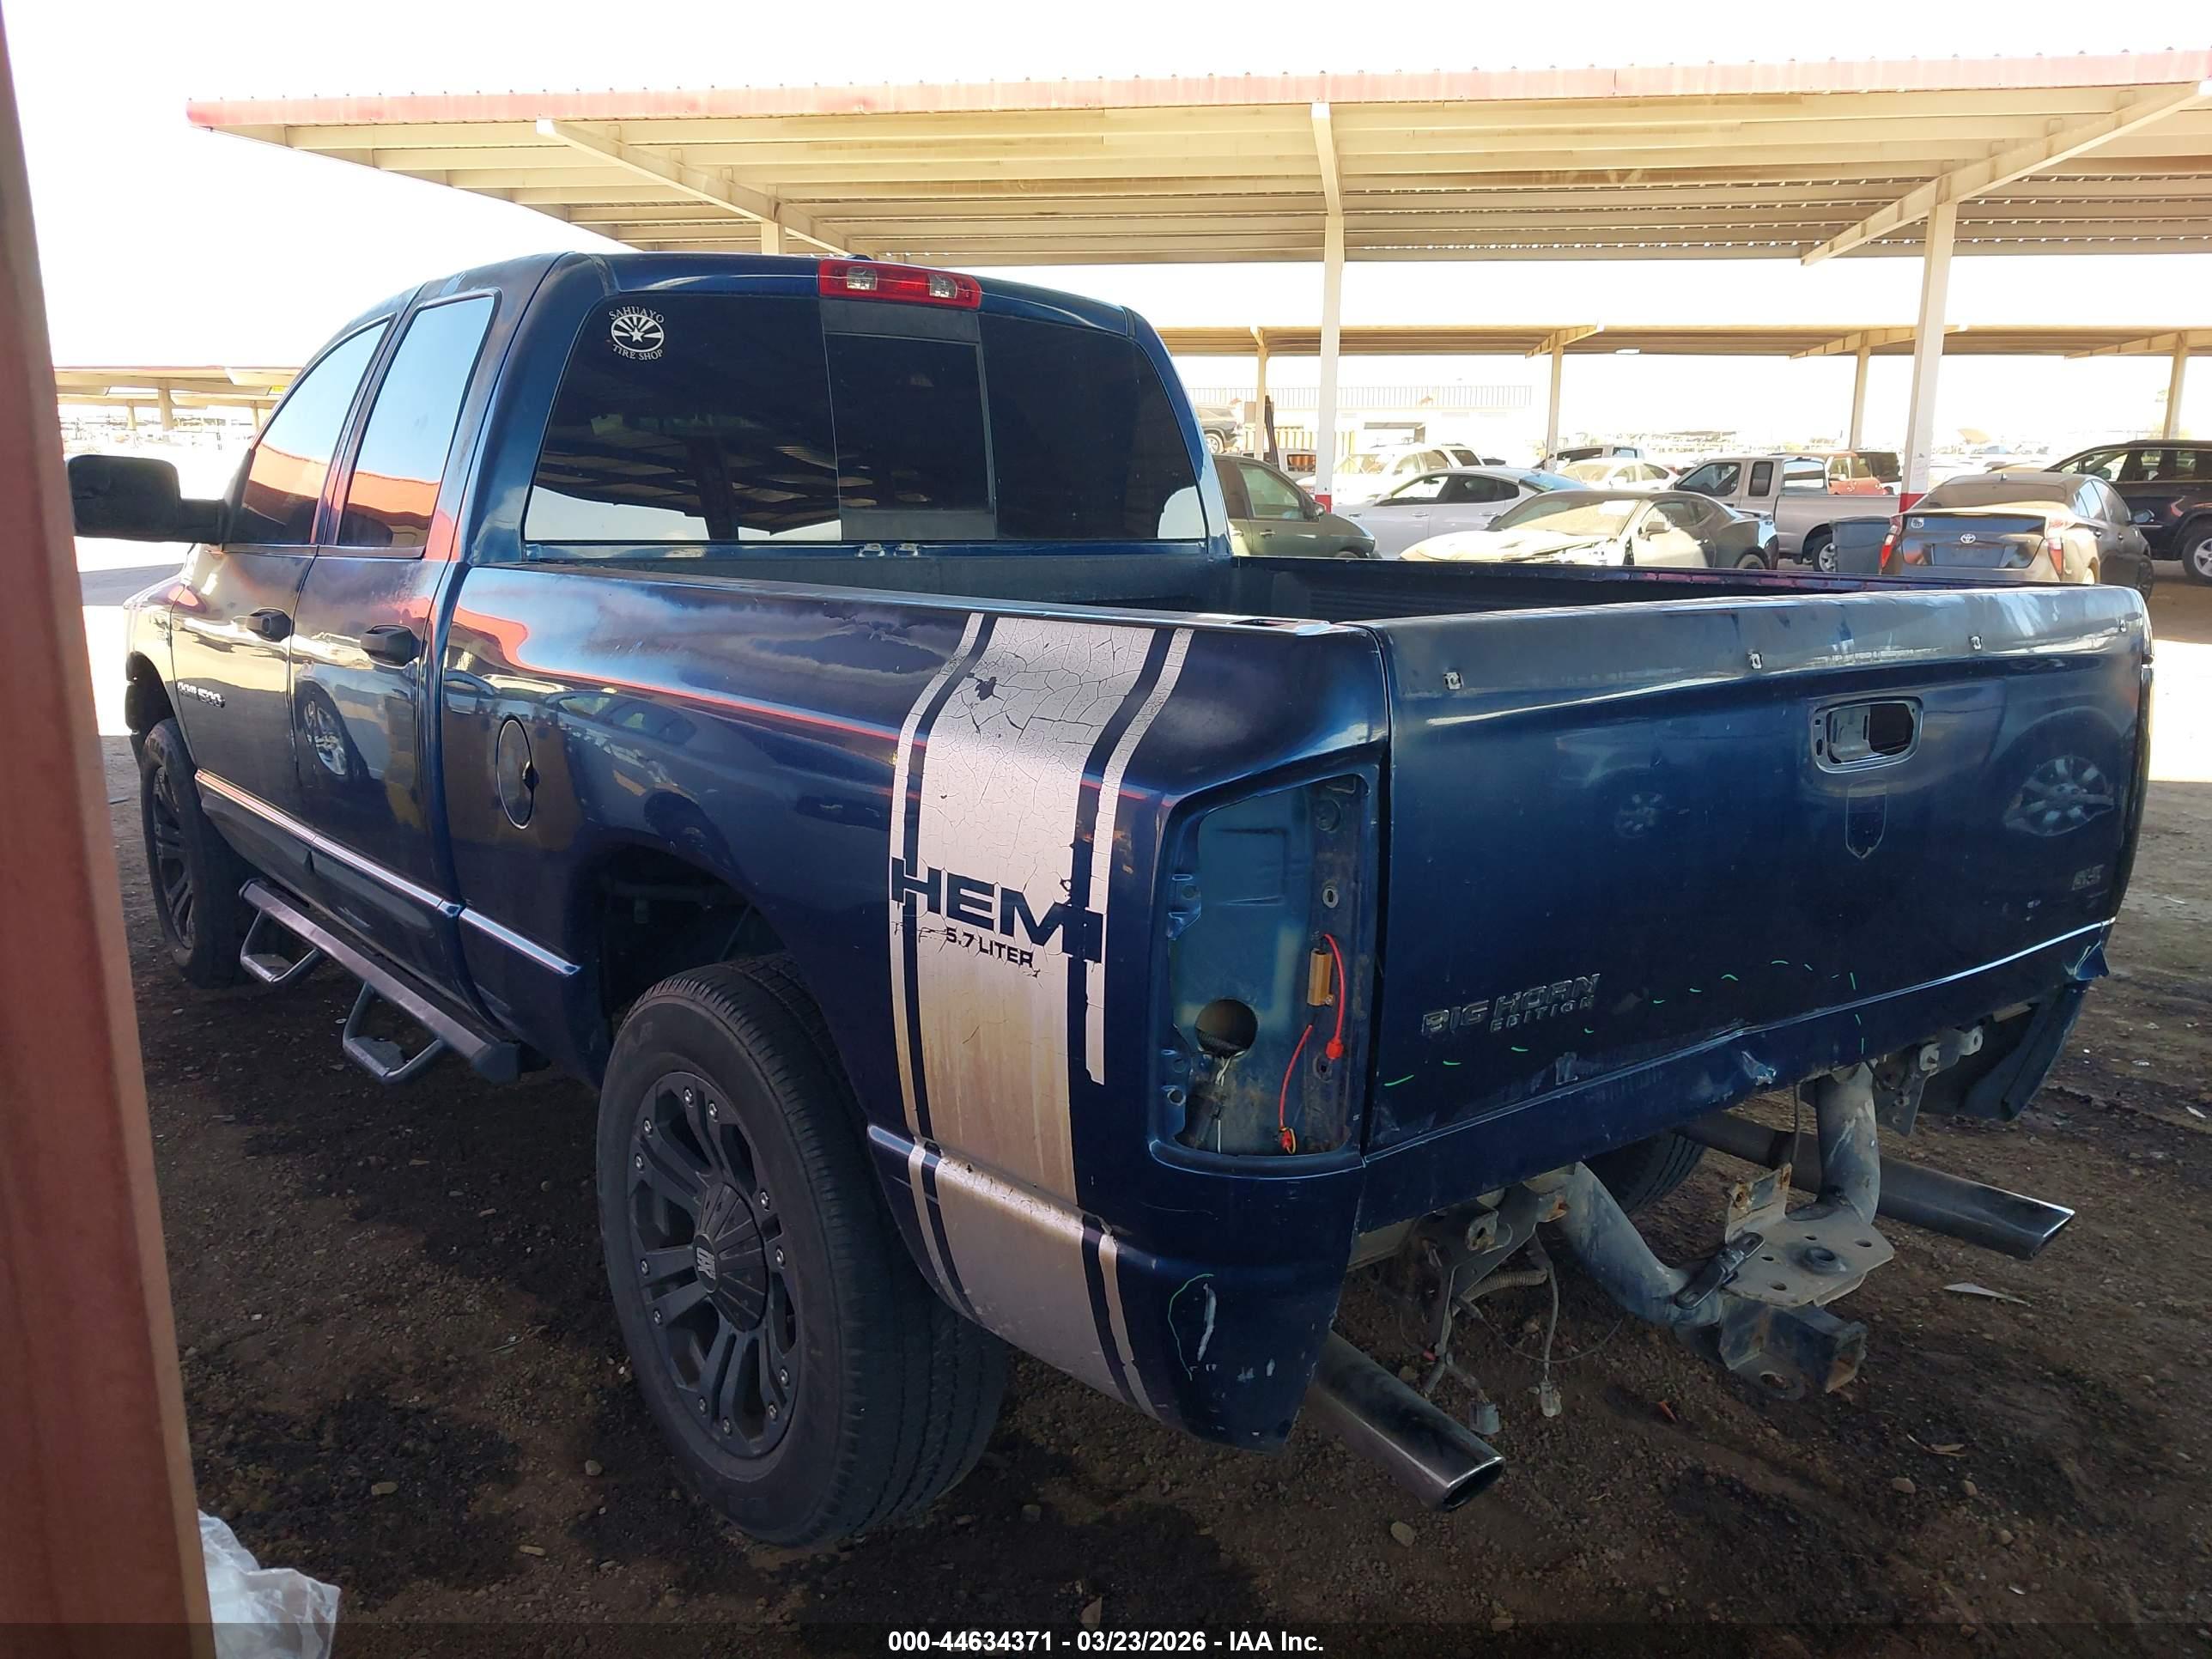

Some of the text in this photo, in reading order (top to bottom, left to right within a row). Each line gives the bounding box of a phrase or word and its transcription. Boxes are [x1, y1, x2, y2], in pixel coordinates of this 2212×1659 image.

[609, 306, 665, 324] SAHUAYO
[612, 344, 663, 361] TIRE SHOP
[891, 856, 1103, 963] HEMI
[945, 927, 1034, 968] 5.7 LITER
[1421, 973, 1601, 1036] BIG HORN
[1490, 995, 1595, 1032] EDITION
